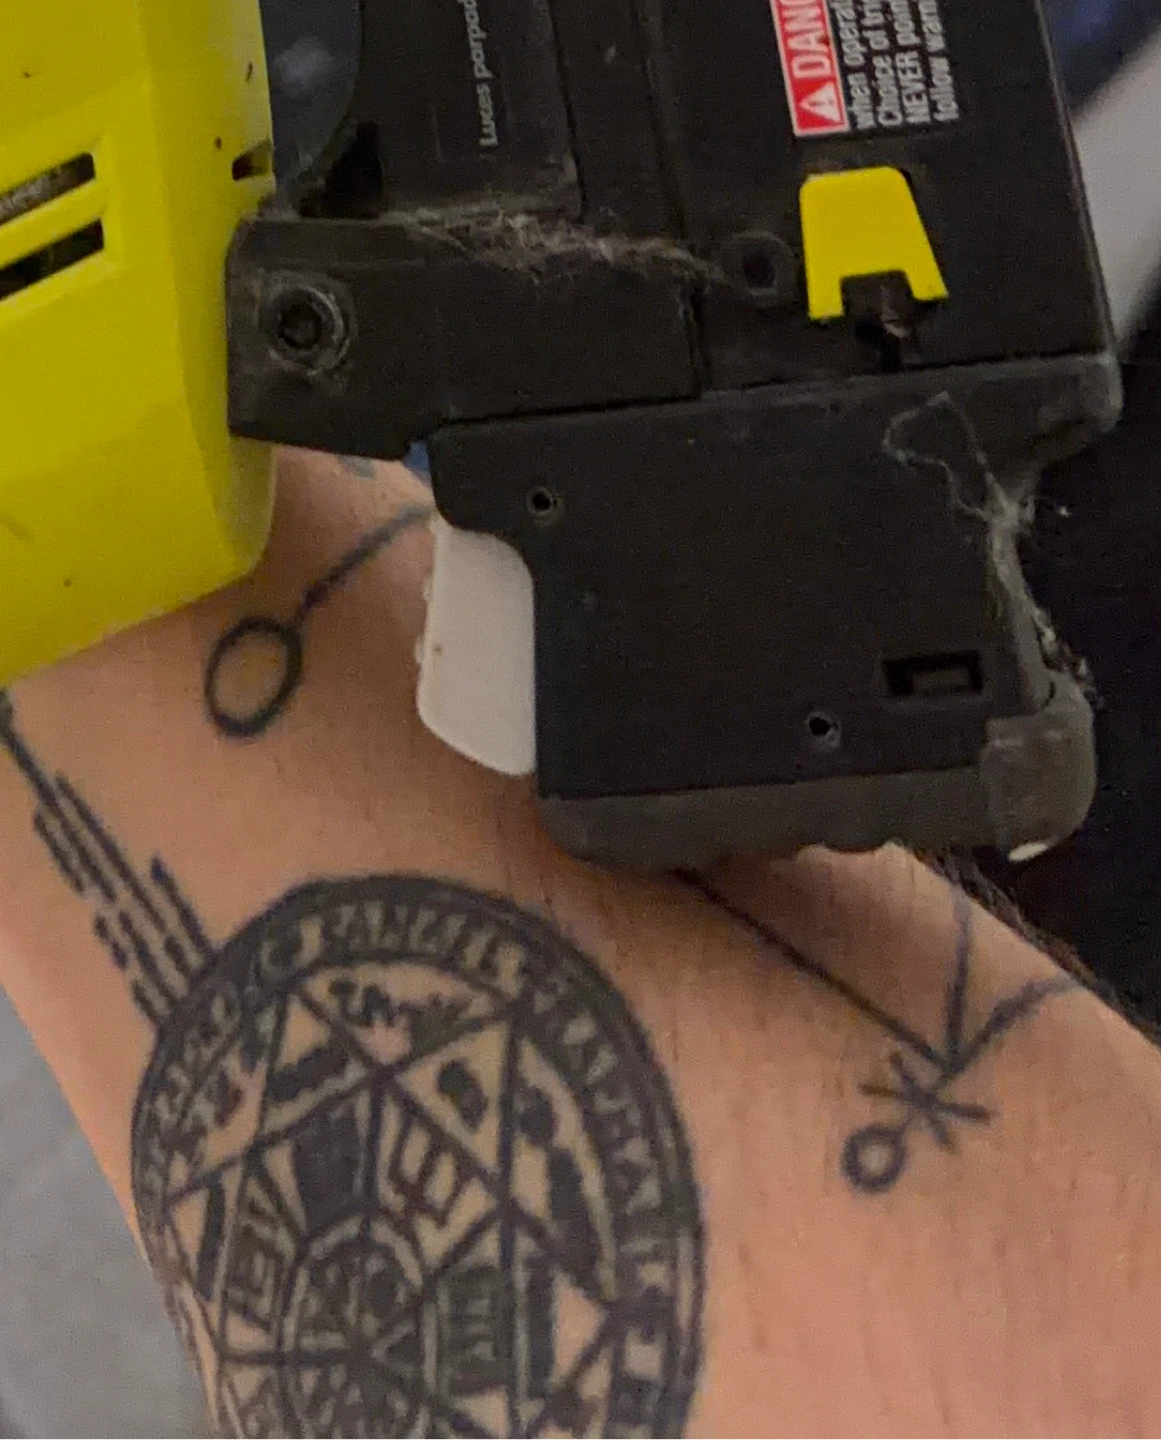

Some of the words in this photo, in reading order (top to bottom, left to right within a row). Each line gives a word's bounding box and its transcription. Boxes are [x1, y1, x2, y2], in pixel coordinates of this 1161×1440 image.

[847, 72, 875, 130] when
[872, 55, 902, 127] Choice
[895, 51, 930, 123] NEVER
[929, 57, 957, 121] follow
